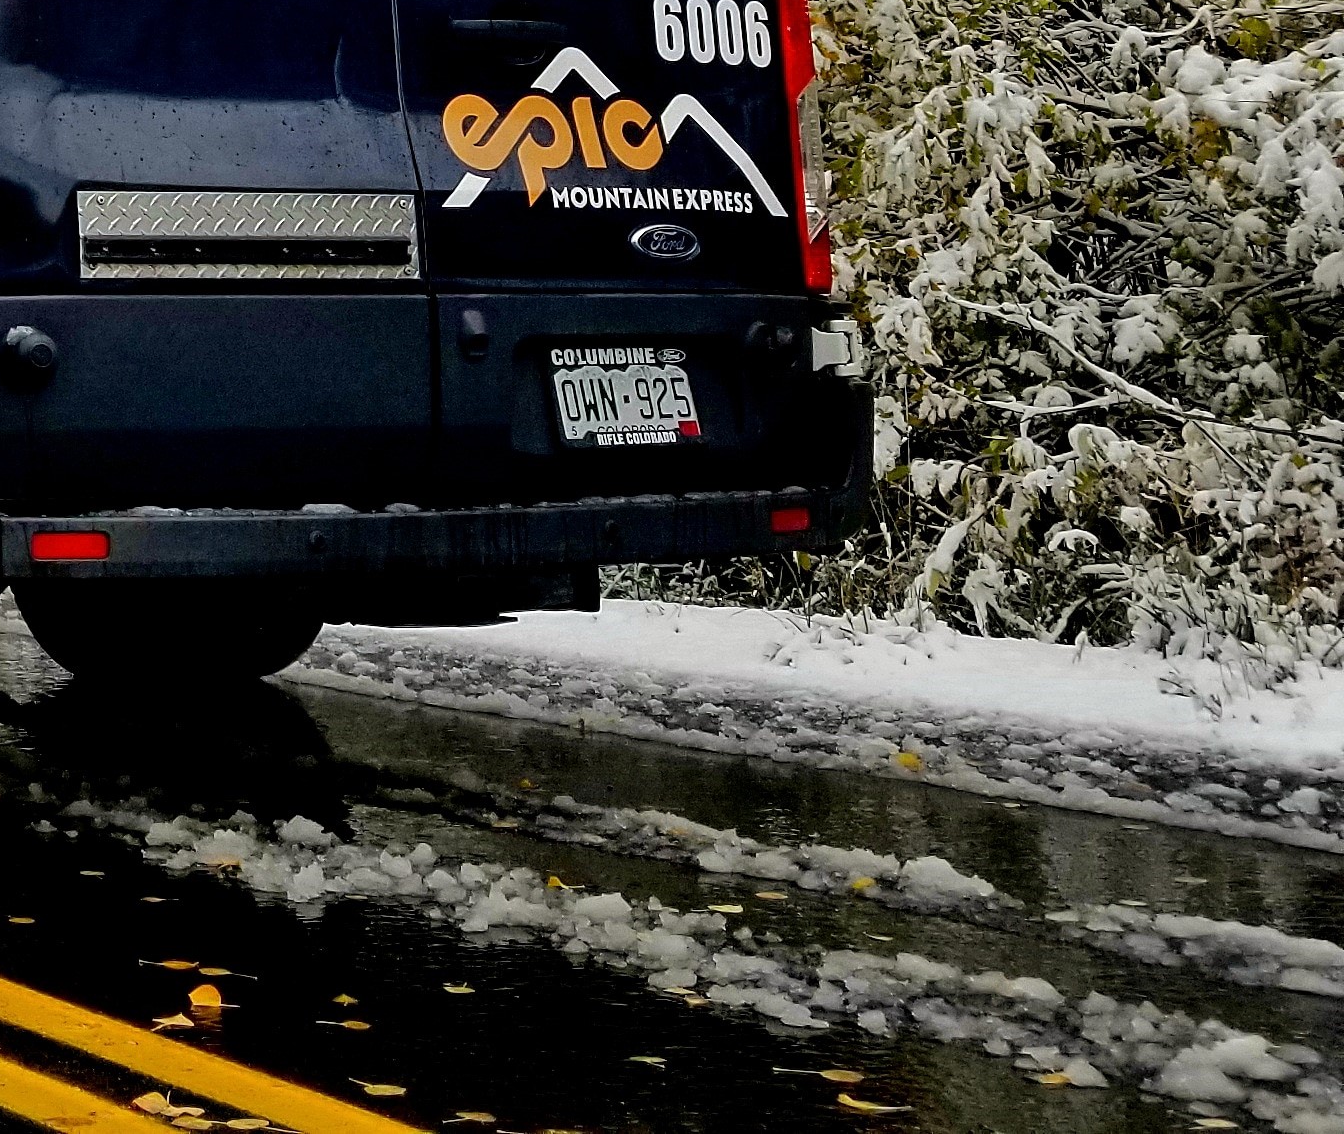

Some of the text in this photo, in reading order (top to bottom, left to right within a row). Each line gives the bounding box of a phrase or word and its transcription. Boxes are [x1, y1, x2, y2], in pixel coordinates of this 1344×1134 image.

[442, 93, 664, 207] epic
[552, 187, 753, 213] MOUNTAIN EXPRESS
[551, 348, 656, 365] COLUMBINE
[596, 430, 677, 446] RIFLE COLORADO
